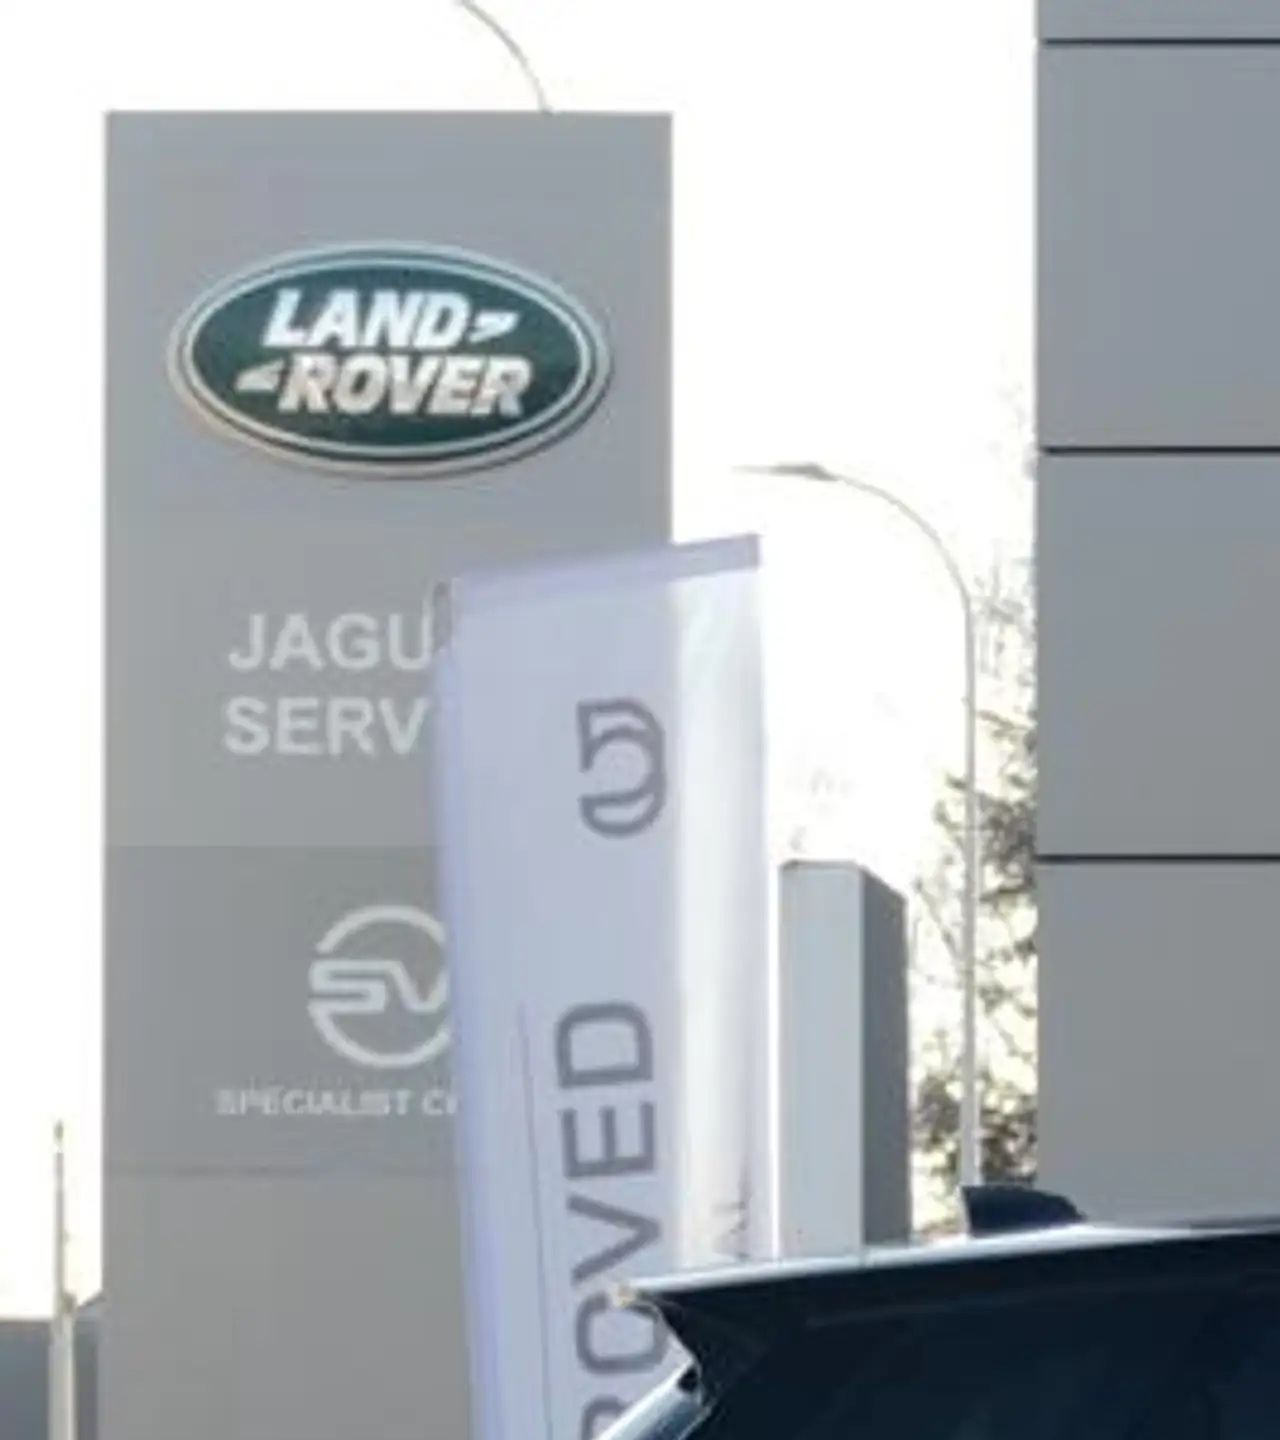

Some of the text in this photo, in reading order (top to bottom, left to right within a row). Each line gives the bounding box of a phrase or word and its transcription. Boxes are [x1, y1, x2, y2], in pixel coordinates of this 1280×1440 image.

[263, 289, 473, 349] LAND
[277, 354, 534, 416] ROVER
[227, 611, 433, 671] JAGU
[223, 696, 428, 756] SERV
